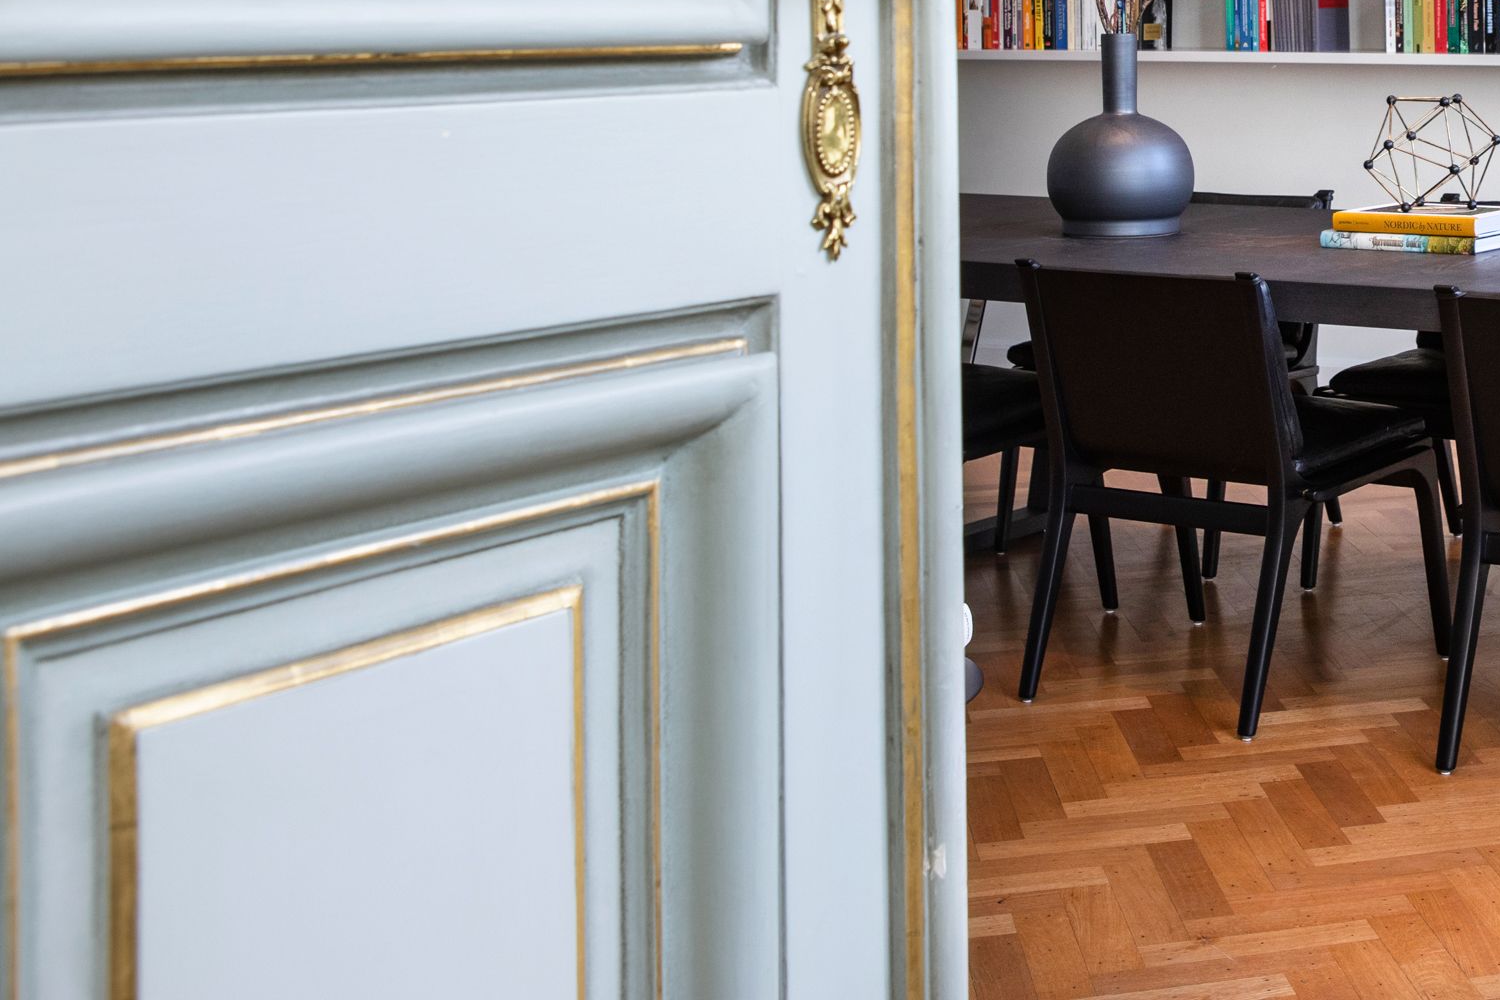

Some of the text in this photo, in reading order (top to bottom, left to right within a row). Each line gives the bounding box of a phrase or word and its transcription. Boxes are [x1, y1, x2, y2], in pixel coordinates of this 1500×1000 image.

[1384, 220, 1462, 232] NORDIC by NATURE
